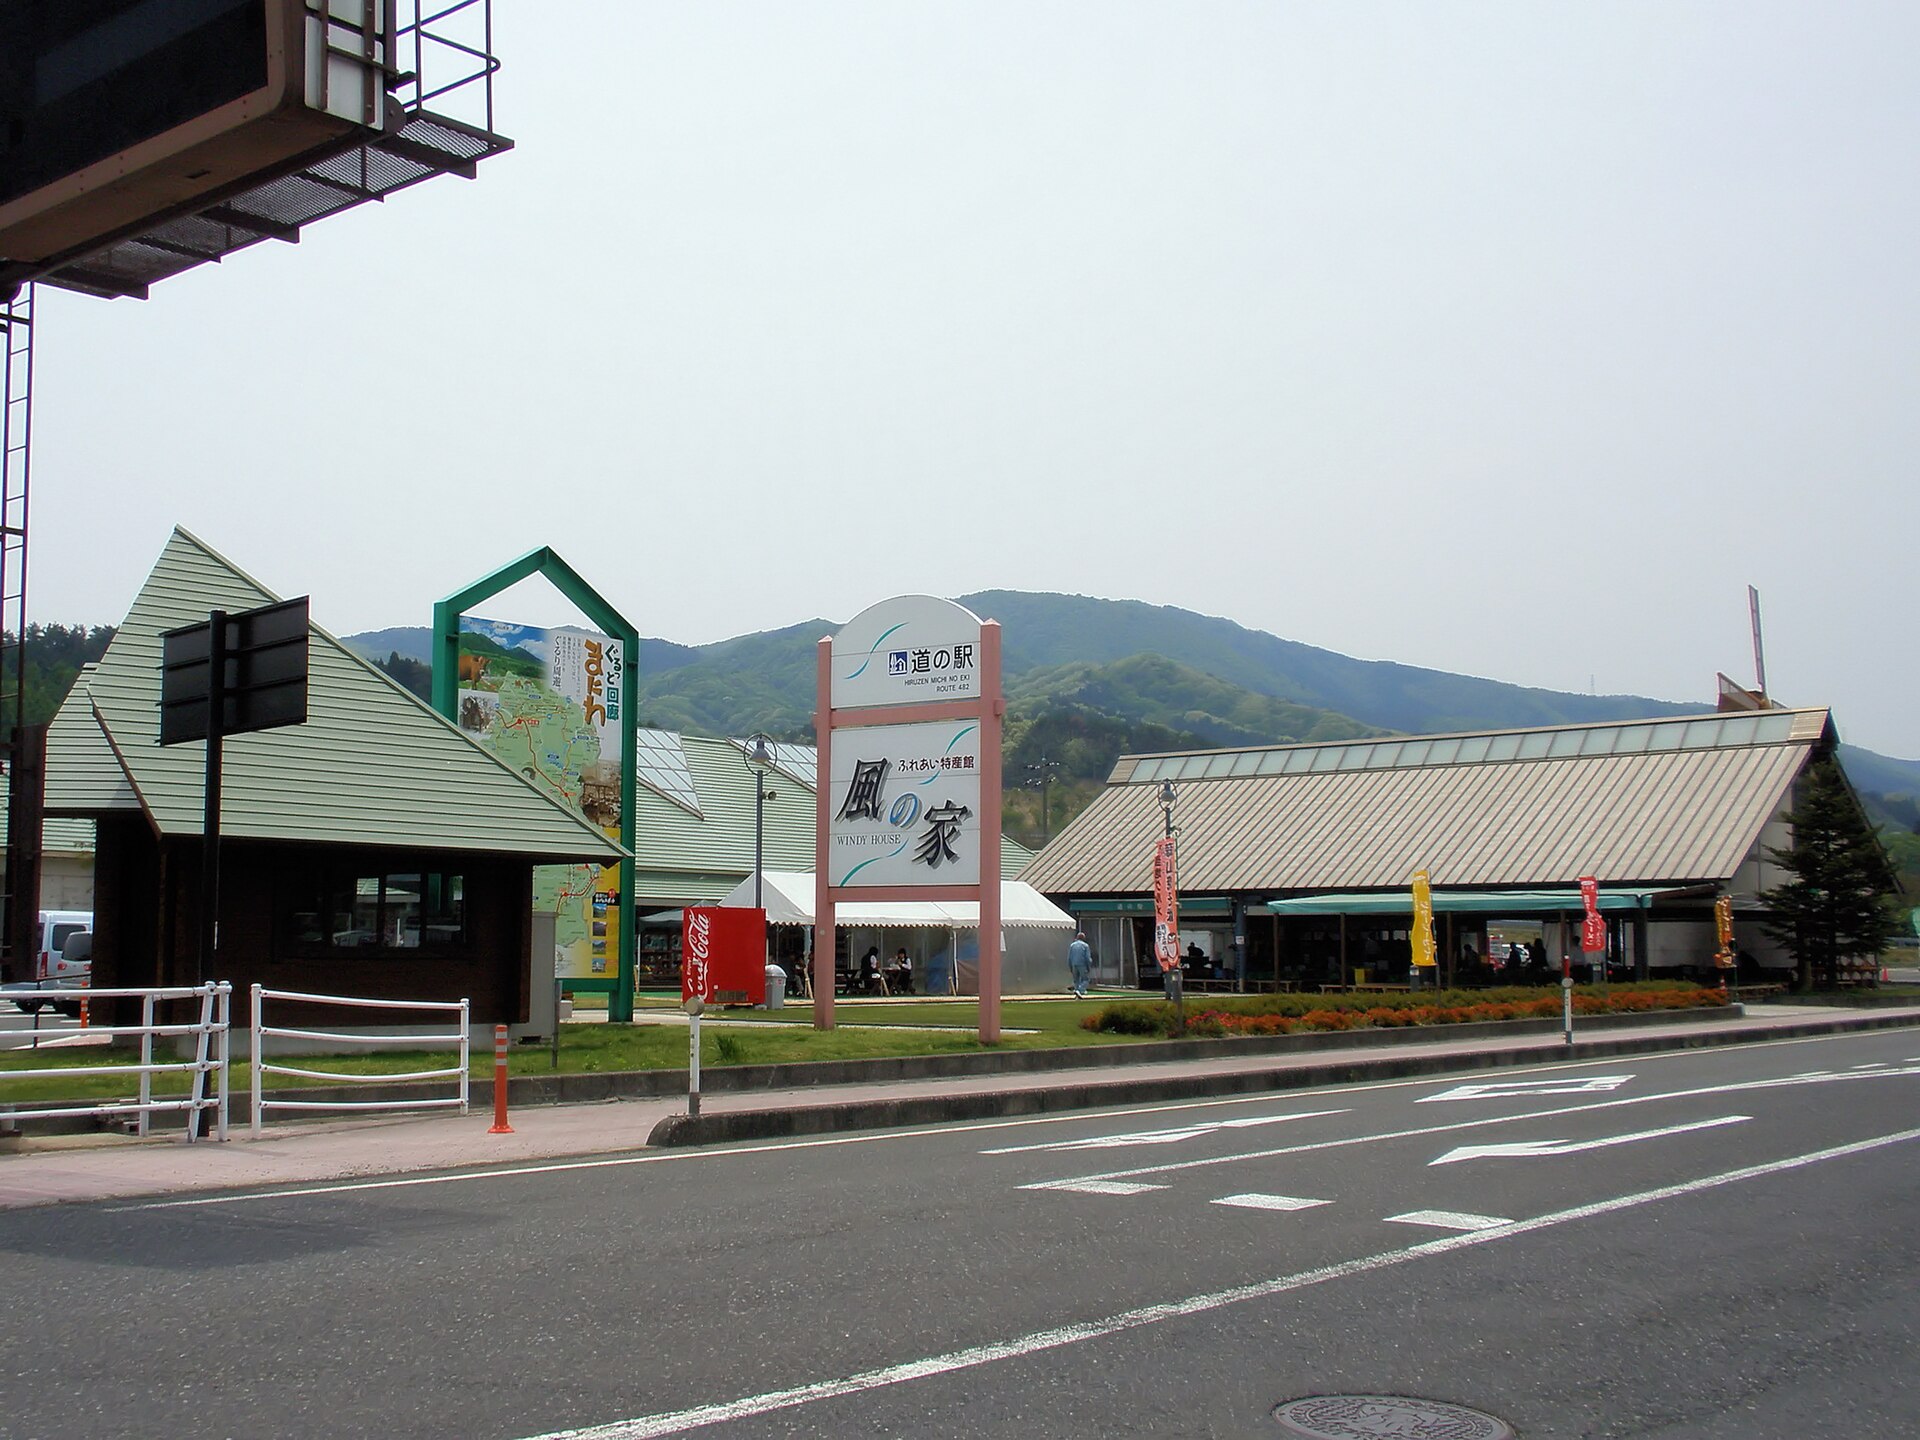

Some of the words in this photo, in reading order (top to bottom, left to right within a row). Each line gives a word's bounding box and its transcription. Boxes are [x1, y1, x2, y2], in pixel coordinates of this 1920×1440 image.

[911, 644, 974, 674] 道の駅
[582, 639, 606, 727] まにわ
[904, 677, 929, 686] HIRUZEN
[931, 676, 947, 684] MICHI
[960, 674, 970, 682] EKI
[936, 684, 956, 692] ROUTE
[898, 756, 975, 772] ふれあい特産館
[834, 758, 971, 867] 風の家
[837, 835, 868, 846] WINDY
[871, 834, 901, 845] HOUSE
[687, 908, 711, 1001] Coca-Cola
